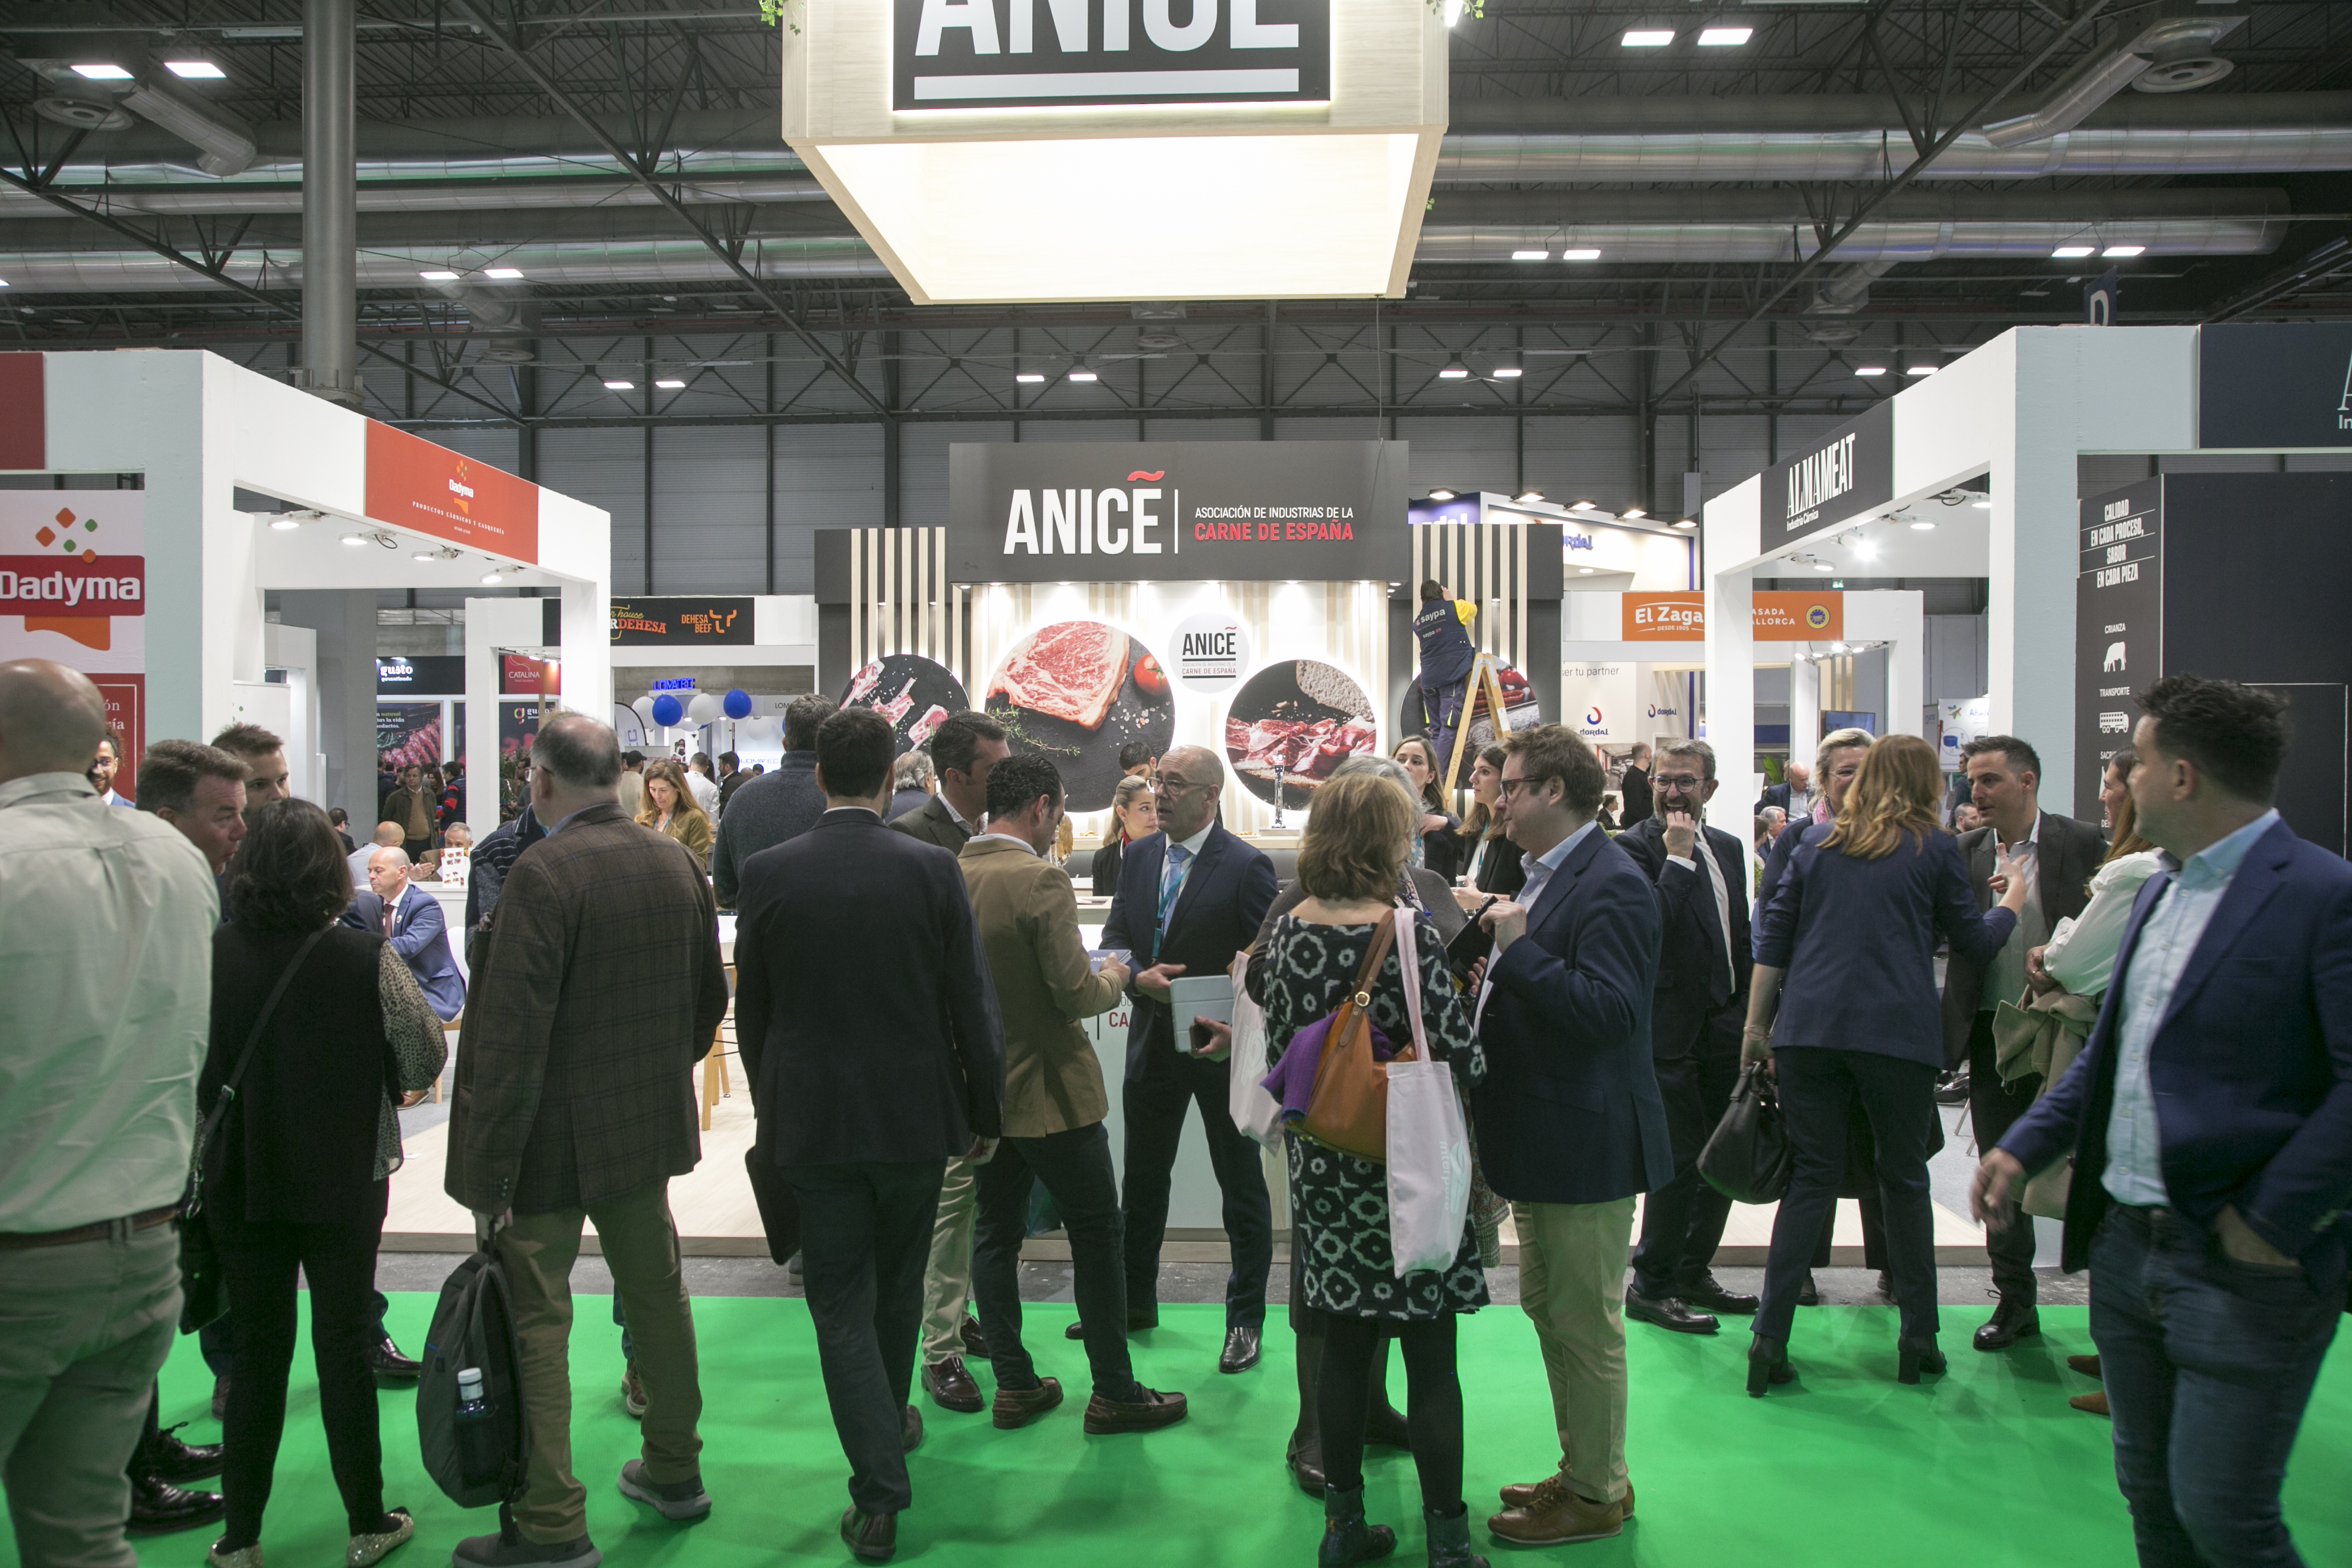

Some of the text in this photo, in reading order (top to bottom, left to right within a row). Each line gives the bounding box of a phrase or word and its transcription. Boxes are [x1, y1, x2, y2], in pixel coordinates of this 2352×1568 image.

[1787, 432, 1855, 519] ALMAMEAT
[449, 479, 473, 498] Dadyma
[413, 501, 444, 516] PRODUCTOS
[1195, 505, 1354, 518] ASOCIACIÓN DE INDUSTRIAS DE LA
[2105, 499, 2129, 521] CALIDAD
[1194, 519, 1354, 540] CARNE DE ESPAÑA
[1787, 515, 1803, 532] Industria
[2091, 517, 2144, 547] EN CADA PROCESO,
[2107, 544, 2126, 564] SABOR
[2097, 563, 2138, 588] EN CADA PIEZA
[0, 571, 141, 606] Dadyma
[617, 609, 644, 619] house
[682, 614, 709, 624] DEHESA
[1421, 609, 1446, 622] saypa
[1635, 606, 1704, 625] El Zaga
[611, 618, 666, 634] RDEHESA
[695, 624, 712, 633] BEEF
[2104, 623, 2126, 634] CRIANZA
[380, 665, 413, 676] gusto
[1213, 666, 1236, 674] ESPAÑA
[1587, 667, 1619, 678] partner
[653, 678, 695, 691] LOMATEC
[2100, 687, 2130, 697] TRANSPORTE
